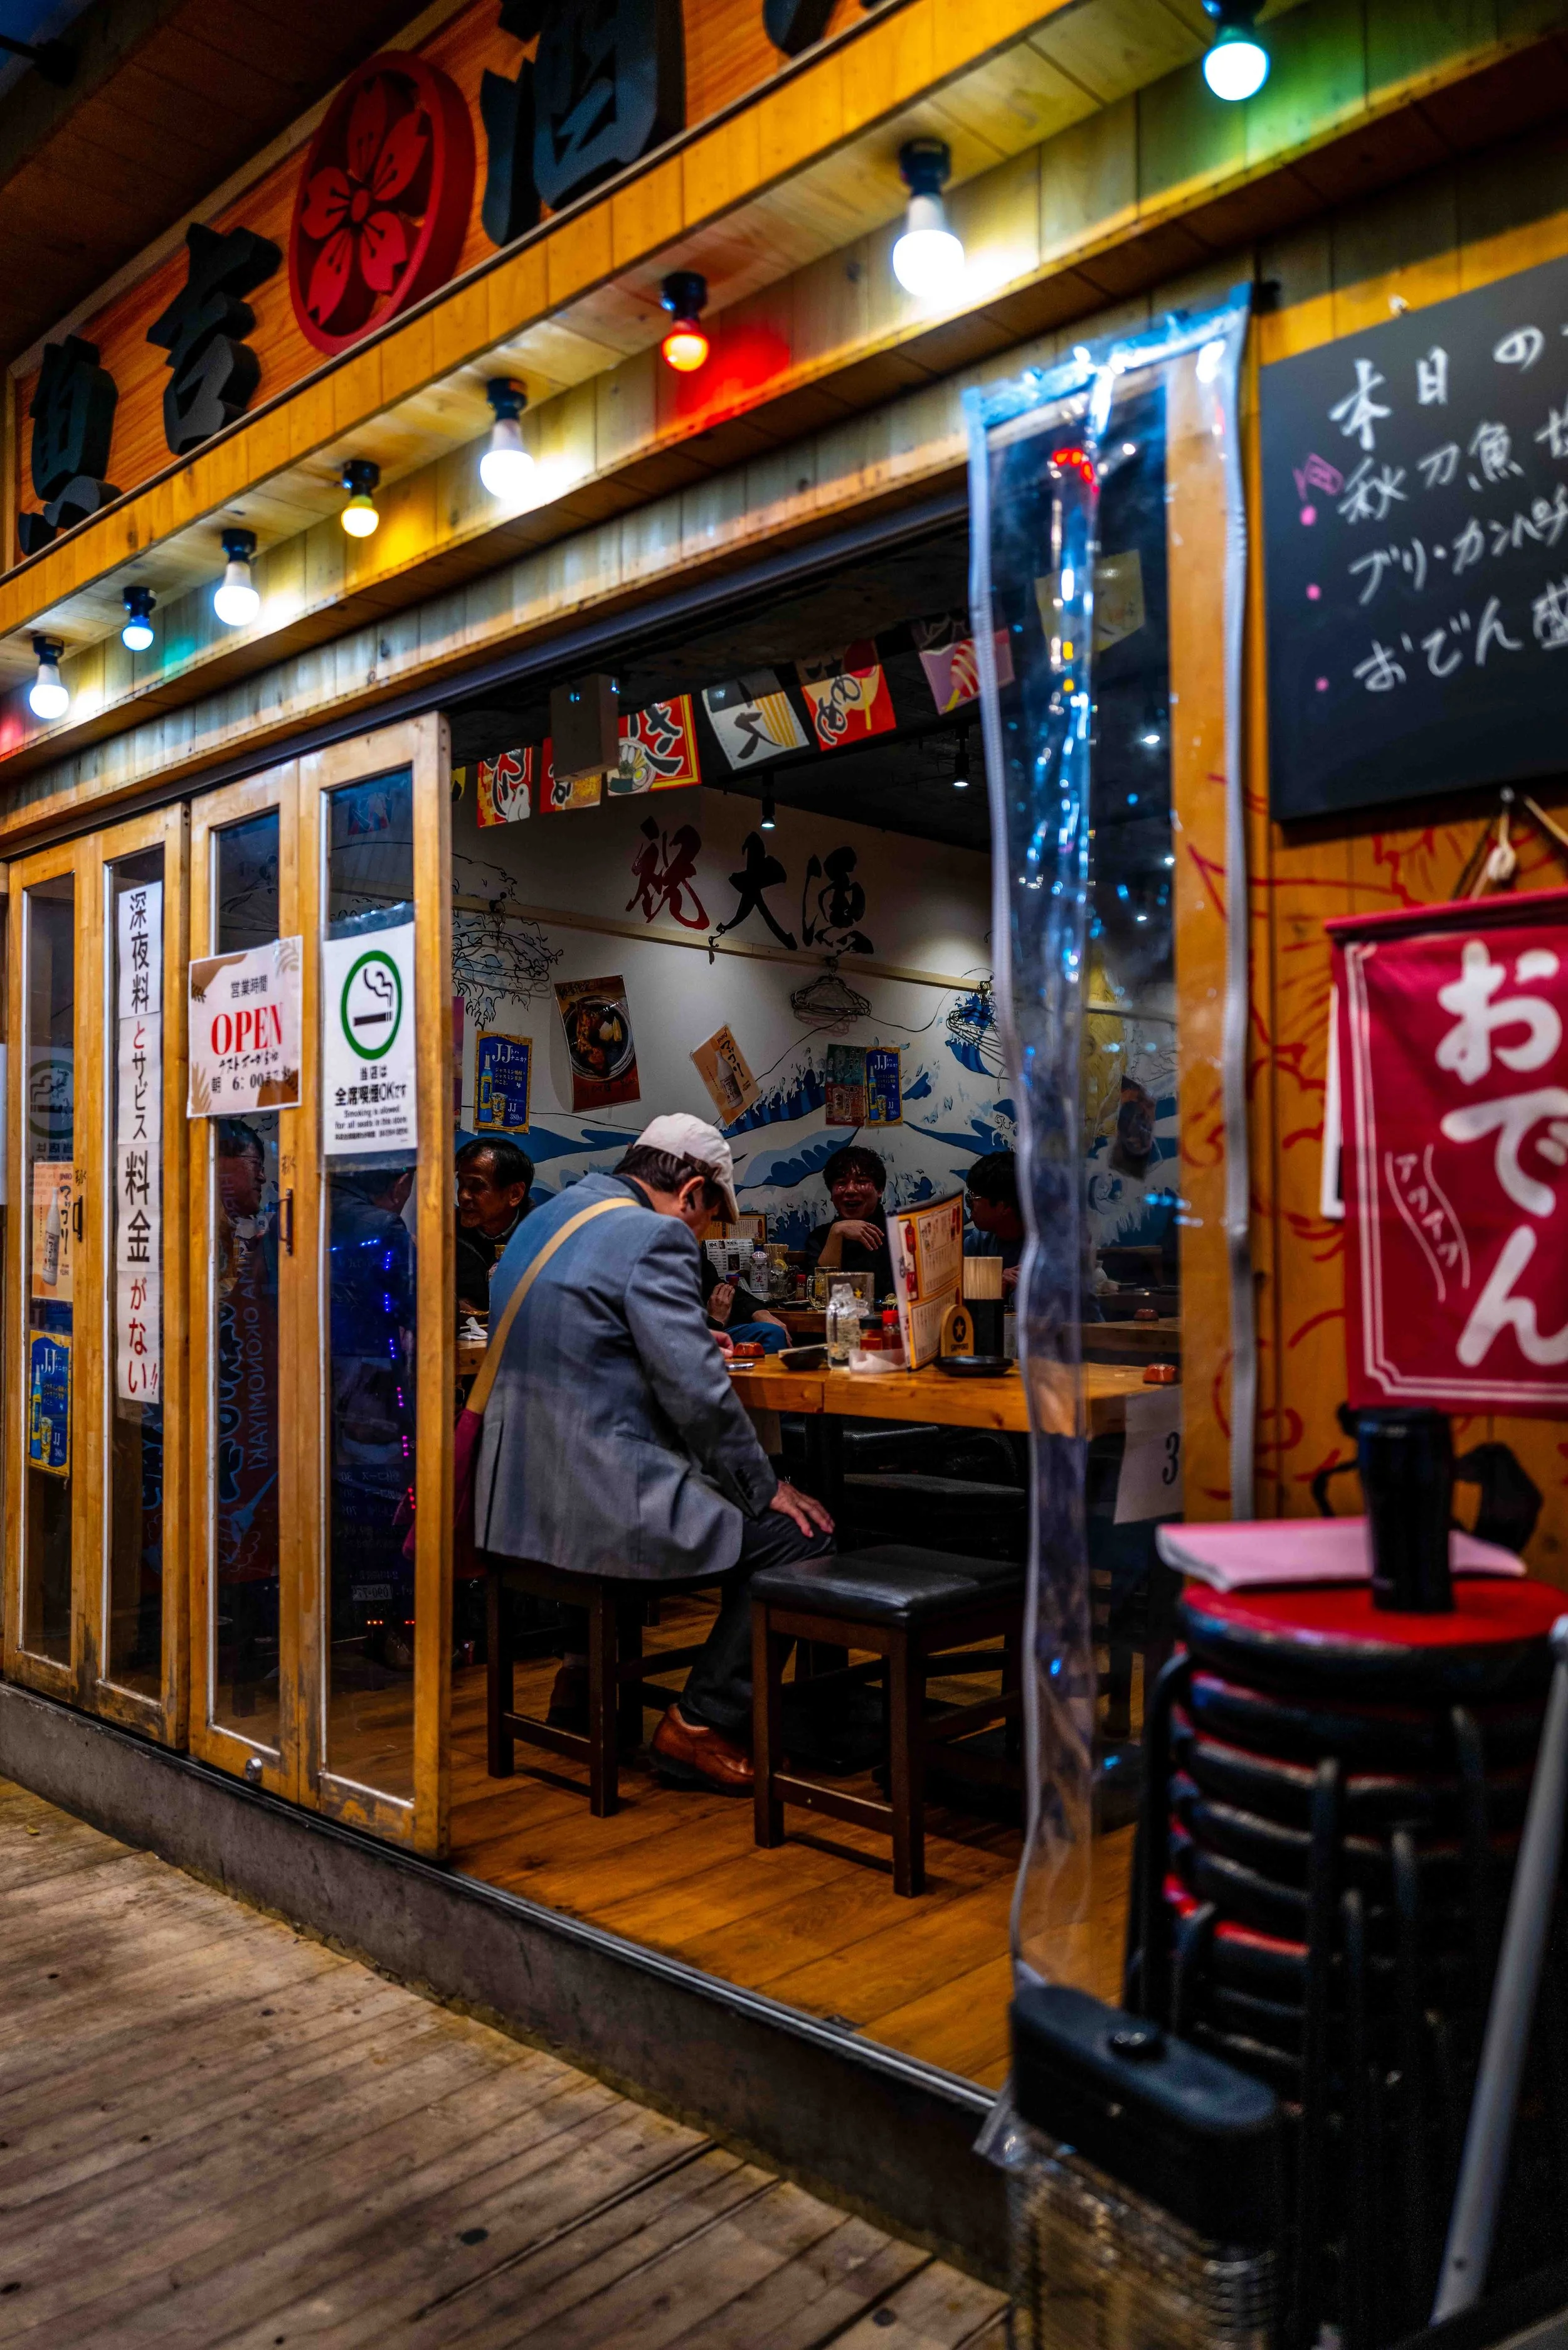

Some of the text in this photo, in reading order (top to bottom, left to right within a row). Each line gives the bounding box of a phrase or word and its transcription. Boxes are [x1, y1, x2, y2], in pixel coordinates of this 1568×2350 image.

[211, 1002, 284, 1056] OPEN
[344, 1109, 372, 1118] Smoking
[1162, 1431, 1180, 1485] 3
